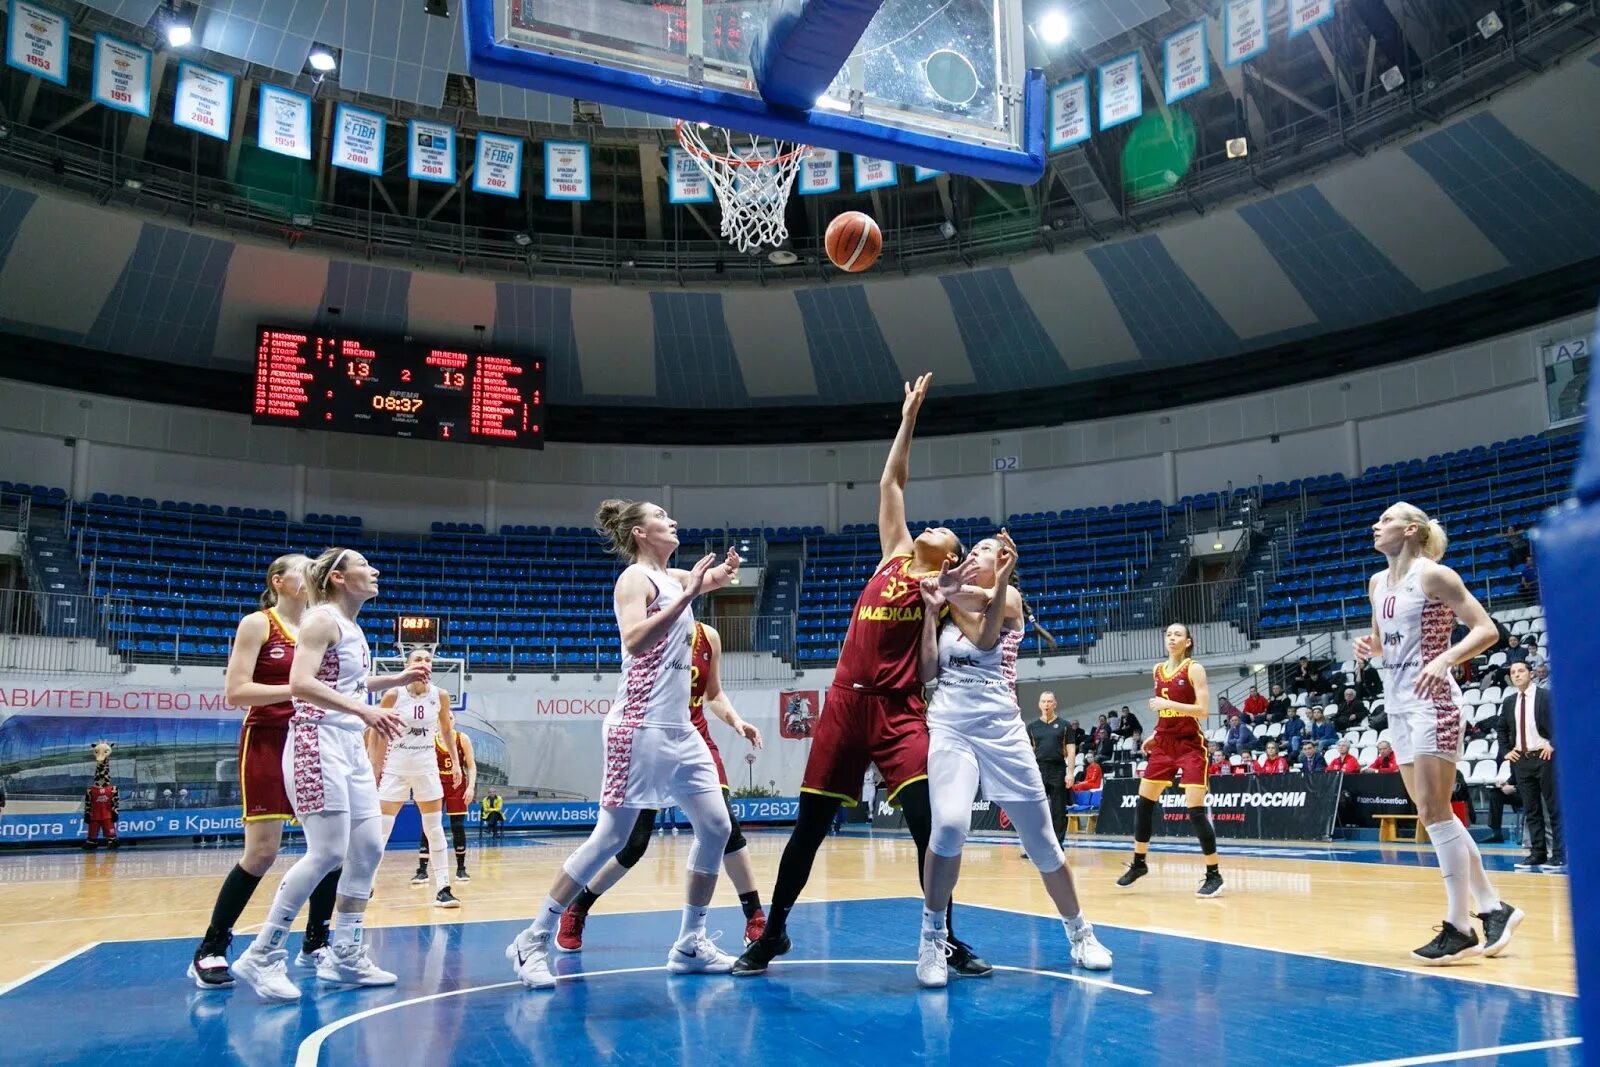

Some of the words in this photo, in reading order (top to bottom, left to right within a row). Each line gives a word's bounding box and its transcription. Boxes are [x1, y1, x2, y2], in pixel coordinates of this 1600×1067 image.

[26, 54, 50, 71] 1953
[111, 90, 132, 103] 1951
[191, 112, 215, 127] 2004
[352, 123, 376, 140] FIBA
[275, 136, 296, 148] 1959
[347, 153, 369, 165] 2000
[491, 149, 514, 165] FIBA
[422, 164, 443, 175] 2004
[683, 159, 701, 172] FIB
[487, 177, 507, 188] 2002
[559, 184, 577, 192] 1966
[683, 187, 700, 195] 1991
[347, 361, 369, 377] 13
[402, 369, 411, 381] 2
[443, 371, 465, 386] 13
[390, 390, 420, 399] ВРЕМЯ
[373, 395, 423, 412] 08:37
[443, 426, 449, 437] 1
[996, 457, 1016, 470] D2
[858, 606, 923, 621] НАДЕЖДА
[1383, 596, 1396, 619] 10
[414, 706, 425, 719] 18
[537, 699, 615, 715] МОСКО
[445, 758, 452, 768] 6
[971, 799, 991, 811] asket
[1121, 795, 1140, 808] XX
[1159, 793, 1241, 807] ЧЕМОНАТ
[1241, 791, 1307, 807] РОССИИ
[0, 822, 64, 839] порта
[169, 819, 180, 831] в
[186, 815, 244, 833] Крыла
